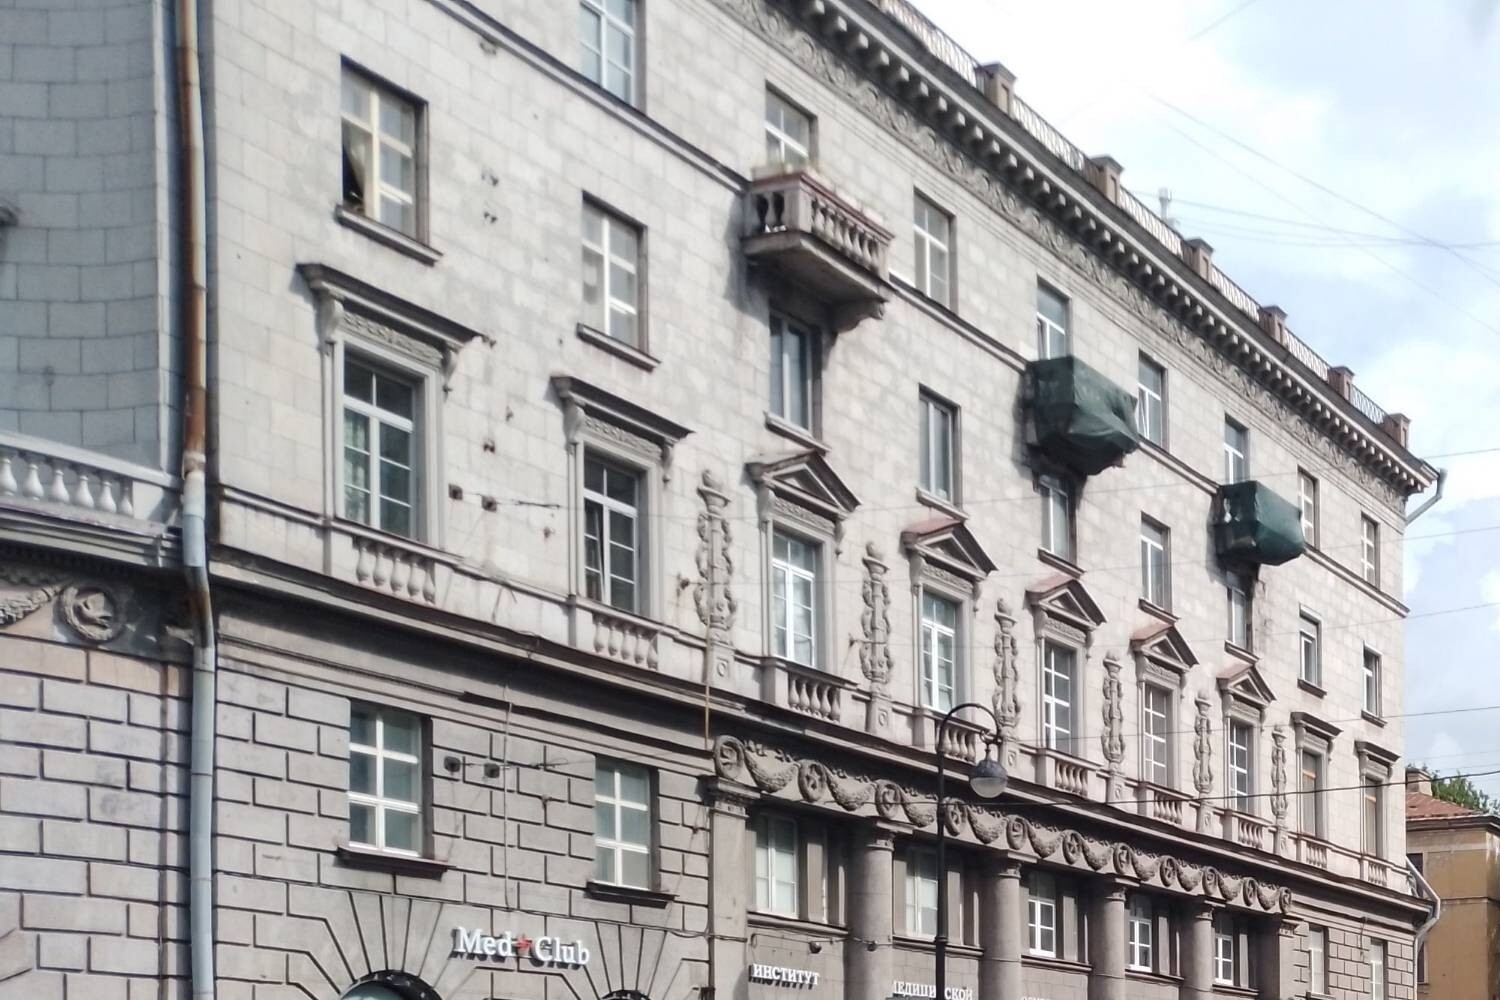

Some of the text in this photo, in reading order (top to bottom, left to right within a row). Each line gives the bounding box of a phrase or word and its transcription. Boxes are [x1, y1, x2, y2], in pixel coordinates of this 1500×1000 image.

[454, 926, 590, 964] Med Club
[752, 963, 820, 985] ИНСТИТУТ
